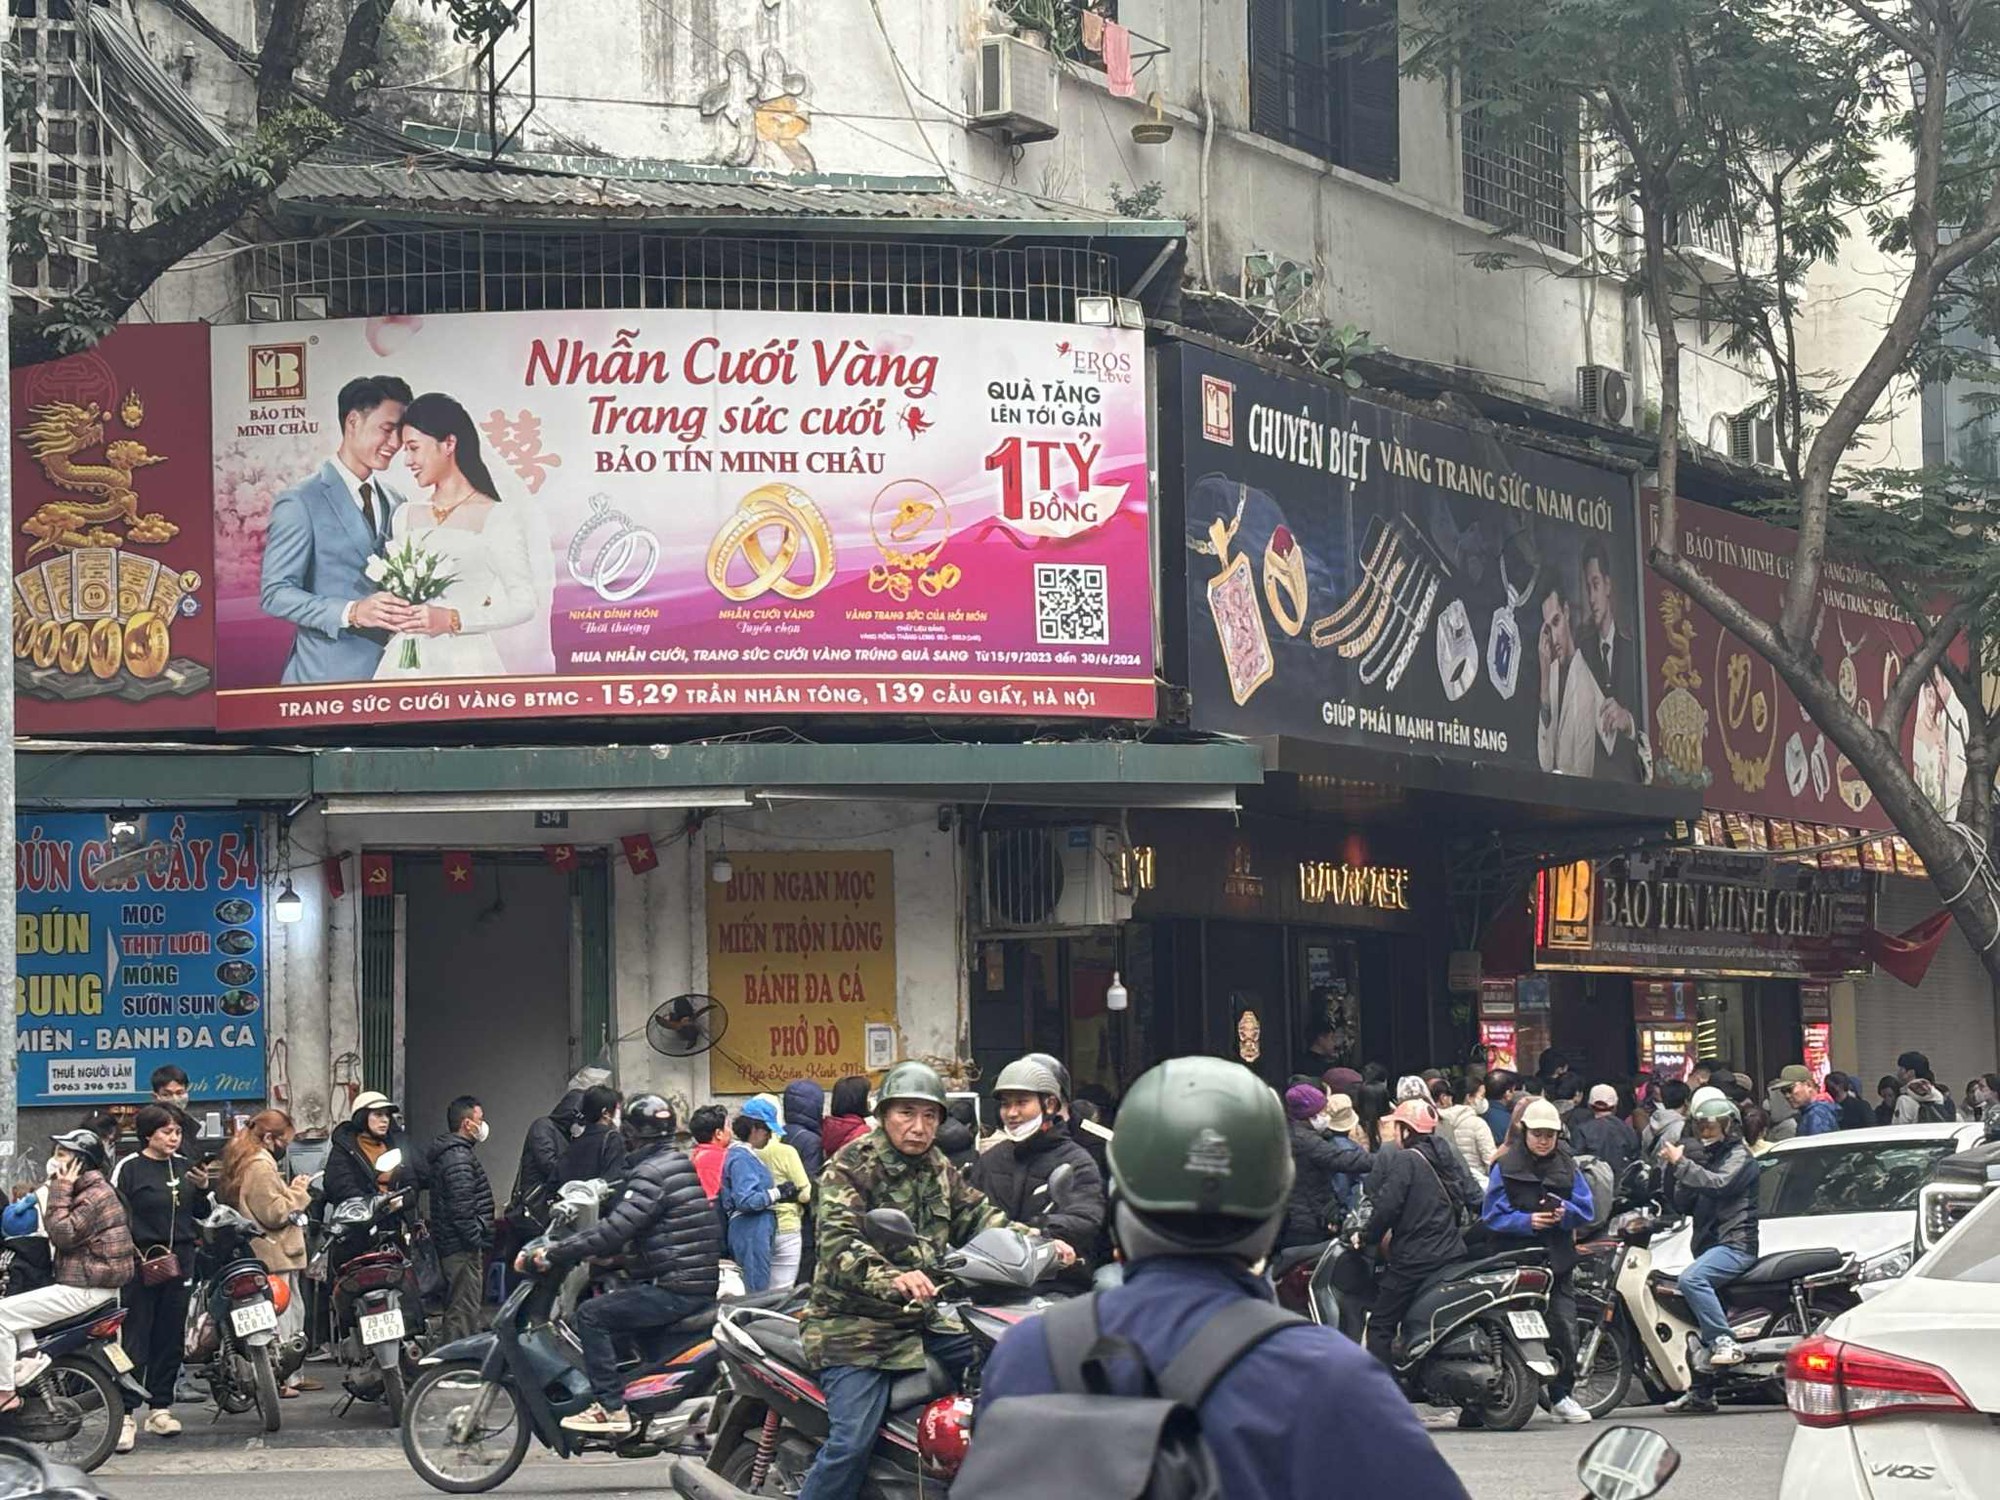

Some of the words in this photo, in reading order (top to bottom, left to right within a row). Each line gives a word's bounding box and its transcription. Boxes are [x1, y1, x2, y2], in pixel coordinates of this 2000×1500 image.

[524, 328, 669, 387] Nhẫn
[683, 337, 799, 386] Cưới
[812, 339, 939, 399] Vàng
[1074, 351, 1131, 371] EROS
[1098, 372, 1131, 383] Love
[988, 378, 1035, 401] QUÀ
[1042, 380, 1100, 408] TẶNG
[250, 407, 279, 420] BẢO
[281, 405, 306, 419] TÍN
[588, 395, 707, 443] Trang
[719, 396, 788, 433] sức
[800, 398, 887, 436] cưới
[991, 404, 1021, 423] LÊN
[1027, 405, 1055, 425] TỚI
[1062, 405, 1101, 427] GẦN
[237, 424, 275, 437] MINH
[279, 420, 319, 435] CHÂU
[594, 445, 656, 473] BẢO
[663, 445, 713, 473] TÍN
[720, 451, 799, 474] MINH
[806, 446, 886, 475] CHÂU
[1027, 432, 1101, 492] TỶ
[1249, 403, 1324, 470] CHUYÊN
[1329, 420, 1371, 492] BIỆT
[1379, 436, 1432, 484] VÀNG
[1435, 457, 1495, 500] TRANG
[1499, 472, 1533, 511] SỨC
[1535, 486, 1574, 522] NAM
[1577, 496, 1613, 533] GIỚI
[1029, 493, 1098, 522] ĐỒNG
[1686, 526, 1714, 561] BẢO
[1715, 534, 1739, 566] TÍN
[1741, 546, 1775, 576] MINH
[783, 607, 815, 620] VÀNG
[874, 610, 904, 620] TRANG
[571, 651, 601, 663] MUA
[605, 646, 646, 663] NHẪN
[650, 647, 688, 663] CƯỚI,
[693, 649, 739, 661] TRANG
[742, 646, 769, 661] SỨC
[773, 646, 808, 661] CƯỚI
[813, 646, 851, 661] VÀNG
[855, 646, 898, 661] TRÚNG
[901, 647, 930, 662] QUÀ
[933, 650, 969, 662] SANG
[1055, 650, 1076, 663] đến
[1081, 653, 1141, 665] 30/6/2024
[279, 700, 344, 717] TRANG
[352, 694, 391, 713] SỨC
[399, 691, 450, 711] CƯỚI
[459, 690, 516, 708] VÀNG
[524, 691, 579, 707] BTMC
[602, 683, 678, 707] 15,29
[686, 682, 736, 704] TRẦN
[744, 684, 800, 703] NHÂN
[807, 684, 868, 705] TÔNG,
[876, 682, 925, 703] 139
[932, 682, 971, 703] CẦU
[978, 684, 1027, 707] GIẤY,
[1033, 687, 1058, 705] HÀ
[1064, 687, 1096, 709] NỘI
[1322, 699, 1356, 728] GIÚP
[1359, 705, 1391, 735] PHÁI
[1395, 714, 1434, 745] MẠNH
[1437, 717, 1470, 747] THÊM
[1473, 727, 1508, 753] SANG
[219, 832, 259, 891] 54
[726, 864, 765, 902] BÚN
[773, 870, 829, 901] NGAN
[835, 871, 876, 910] MỌC
[121, 903, 166, 929] MỌC
[1704, 882, 1768, 935] MINH
[16, 907, 91, 955] BÚN
[719, 911, 767, 953] MIẾN
[772, 915, 826, 960] TRỘN
[831, 914, 883, 952] LÒNG
[121, 934, 165, 959] THỊT
[122, 962, 179, 986] MÓNG
[745, 965, 799, 1004] BÁNH
[805, 974, 834, 1004] ĐA
[838, 964, 866, 1003] CÁ
[122, 993, 173, 1017] SƯỜN
[178, 994, 217, 1020] SỤN
[176, 1026, 215, 1049] ĐA
[769, 1014, 809, 1057] PHỞ
[814, 1018, 840, 1057] BÒ
